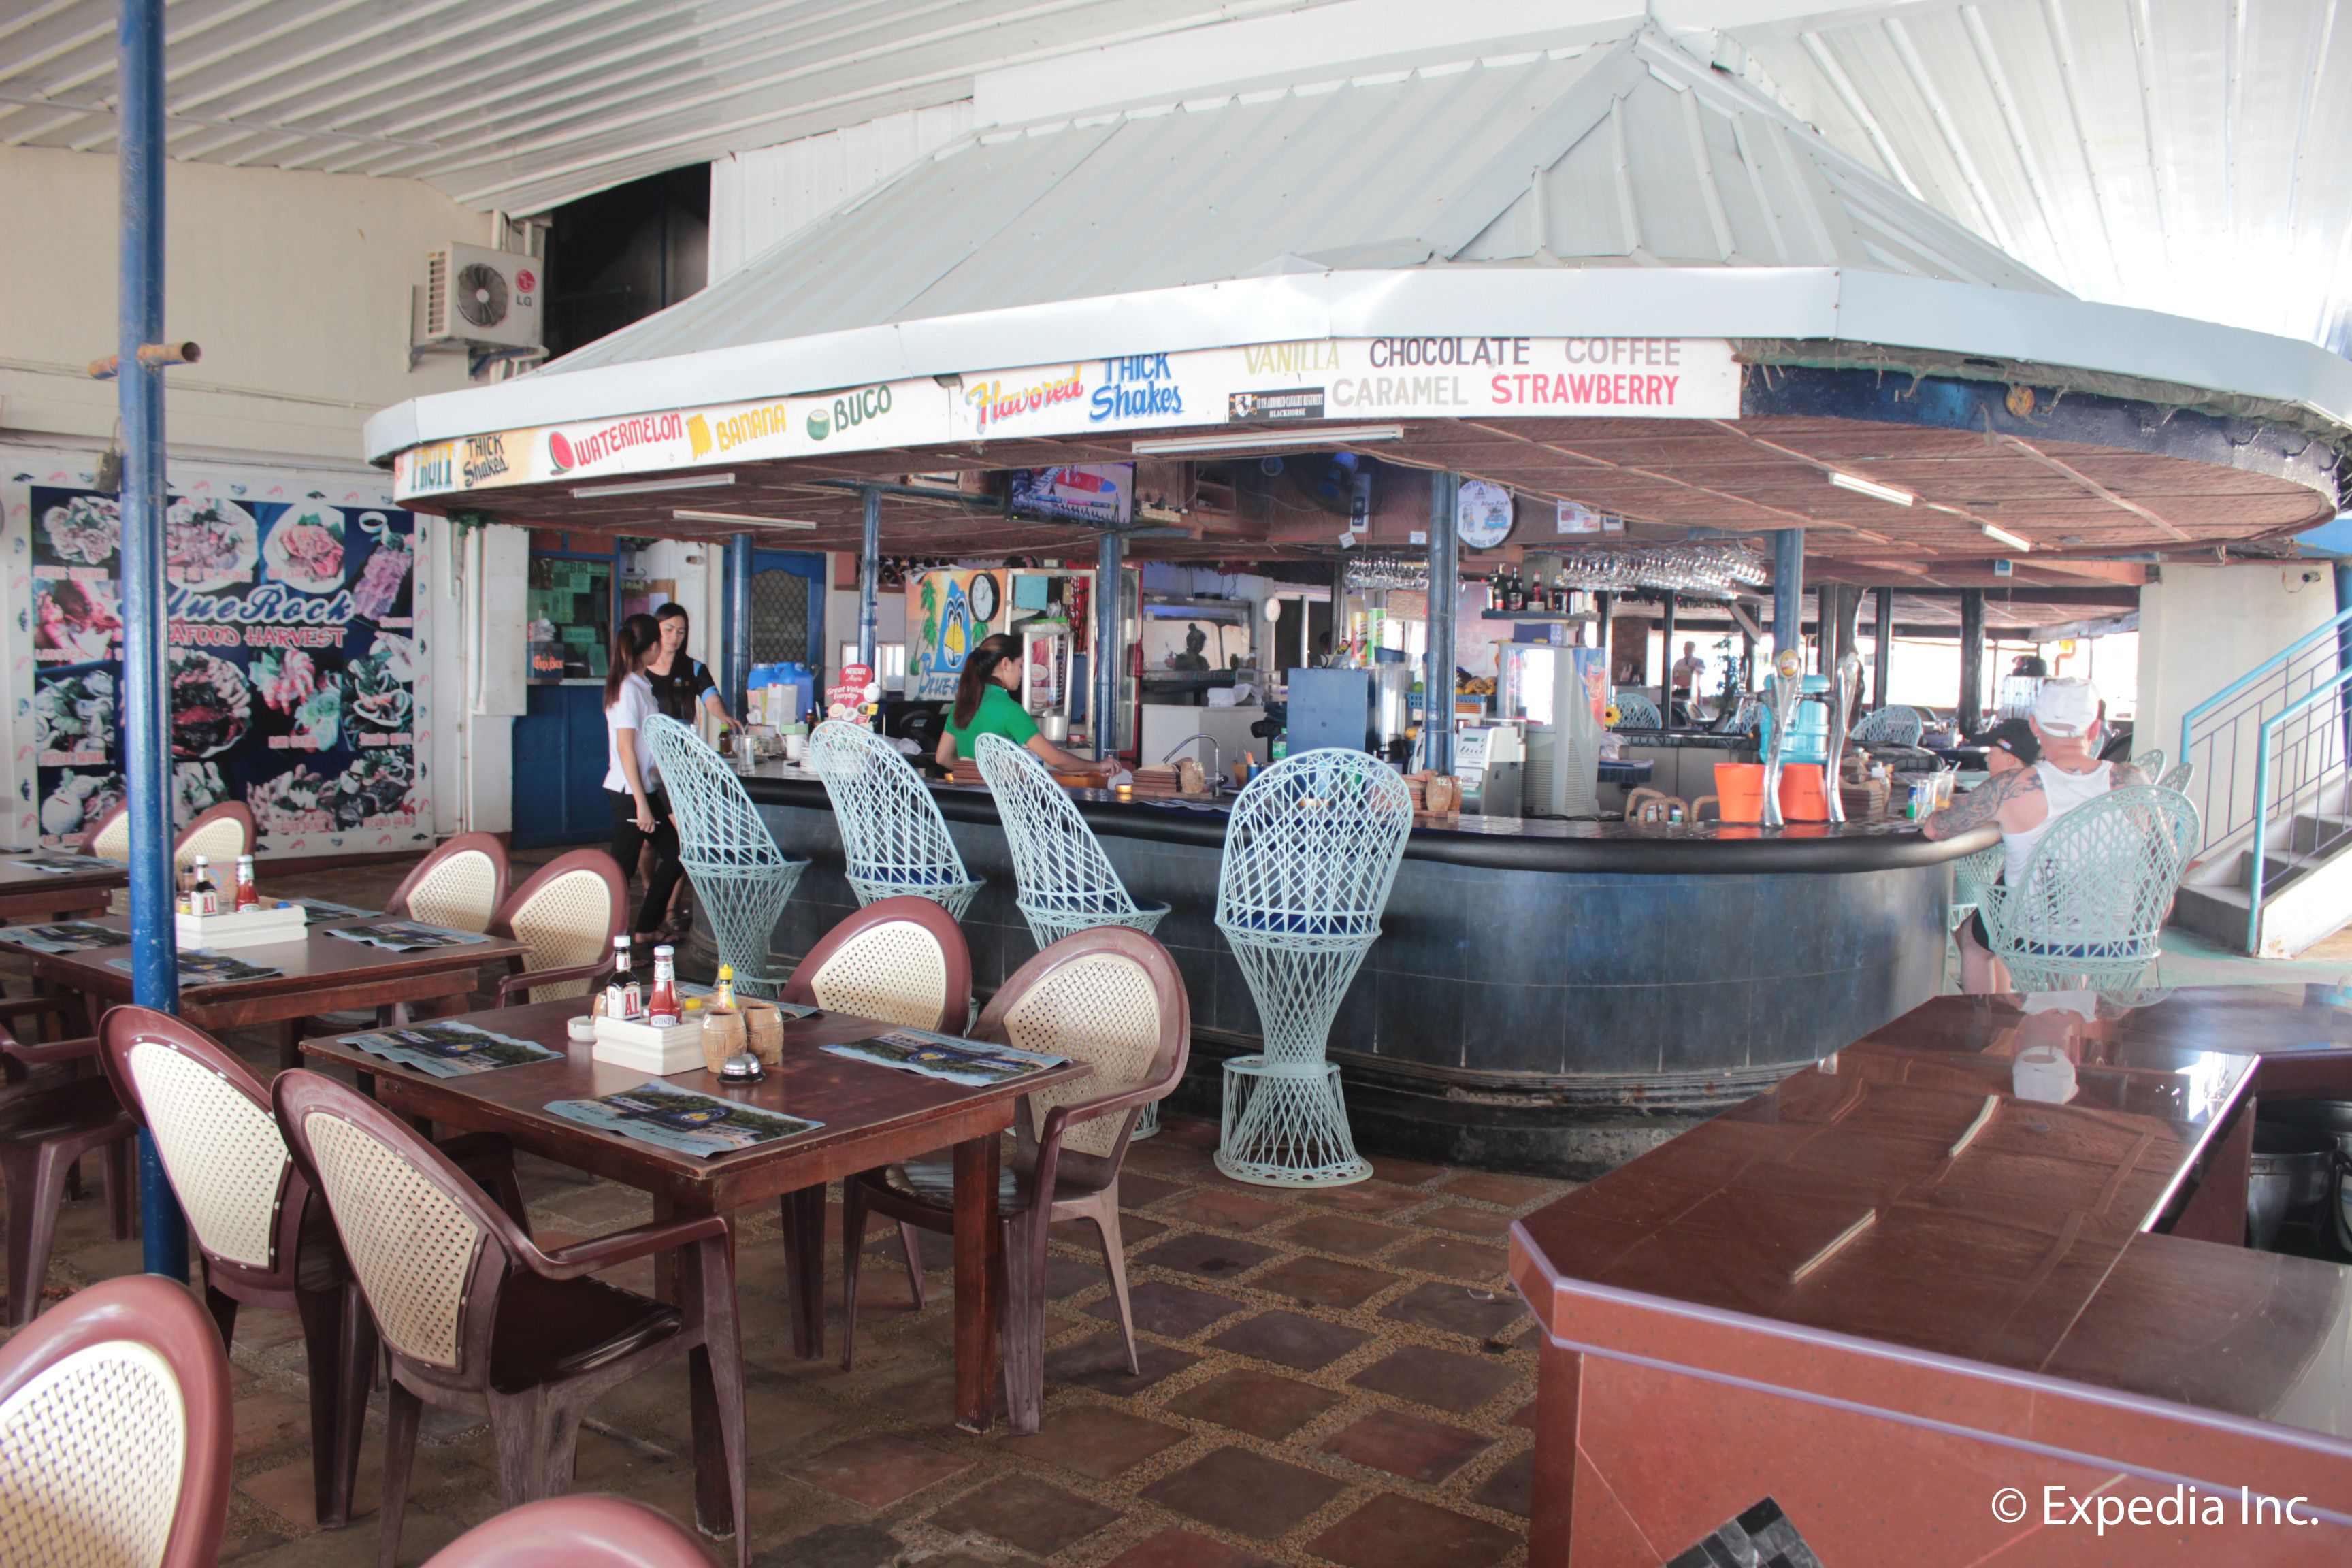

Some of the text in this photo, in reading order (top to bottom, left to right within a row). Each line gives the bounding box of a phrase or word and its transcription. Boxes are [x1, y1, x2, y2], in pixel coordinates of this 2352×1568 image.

[516, 295, 533, 306] LG
[1104, 353, 1171, 383] THICK
[1243, 341, 1340, 375] VANILLA
[1369, 338, 1530, 368] CHOCOLATE
[1565, 338, 1680, 366] COFFEE
[966, 364, 1085, 434] Flavored
[1089, 381, 1183, 421] Shakes
[1332, 376, 1469, 408] CARAMEL
[1491, 373, 1680, 406] STRAWBERRY
[834, 385, 892, 433] BUCO
[574, 413, 683, 466] WATERMELON
[716, 404, 787, 452] BANANA
[466, 434, 504, 458] THICK
[410, 442, 455, 493] FRUIT
[168, 585, 355, 623] lueRock
[169, 624, 347, 647] AFOOD HARVEST
[827, 686, 846, 695] Great
[203, 895, 216, 913] A1
[625, 991, 640, 1016] A1
